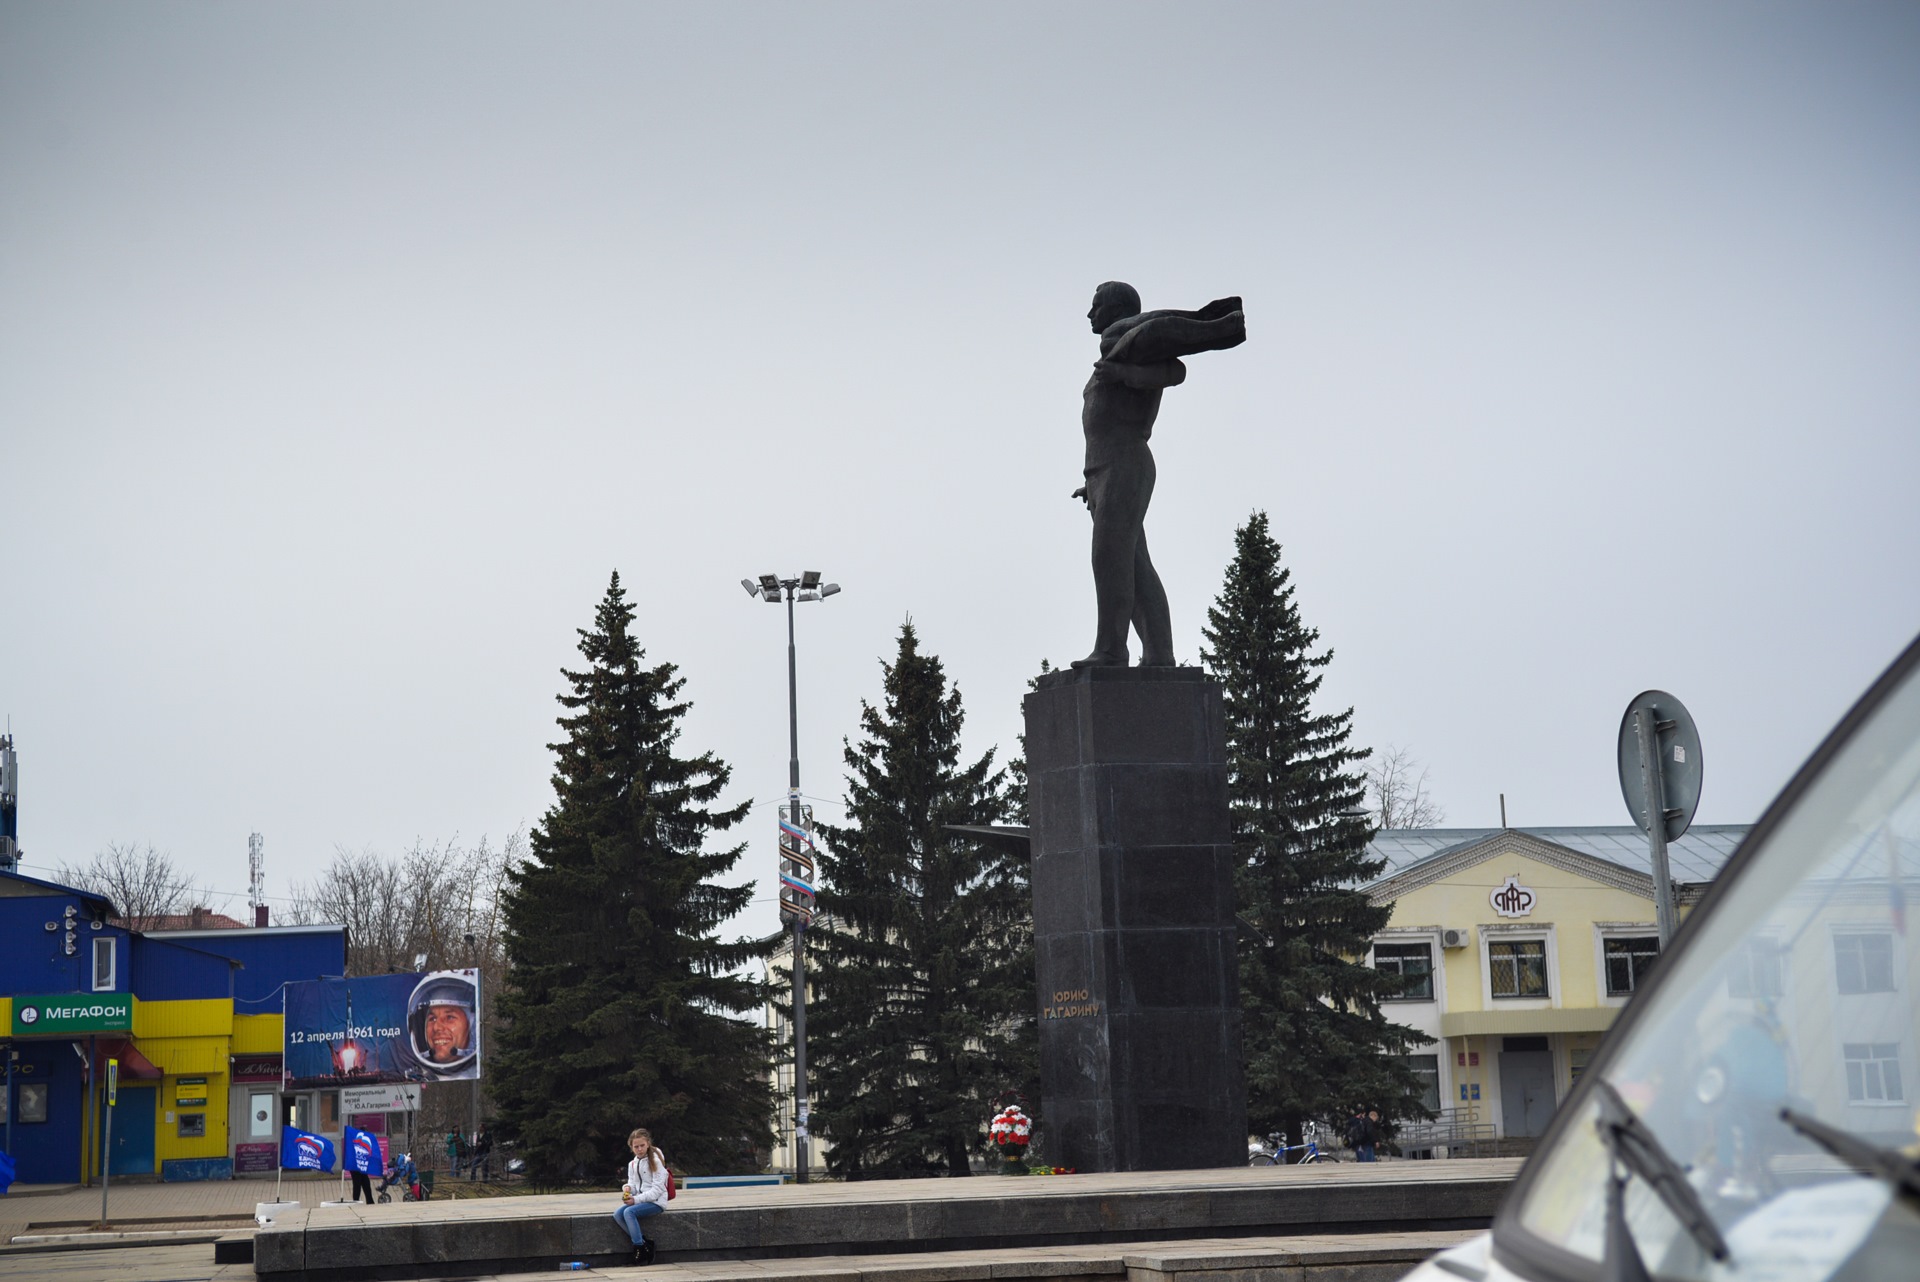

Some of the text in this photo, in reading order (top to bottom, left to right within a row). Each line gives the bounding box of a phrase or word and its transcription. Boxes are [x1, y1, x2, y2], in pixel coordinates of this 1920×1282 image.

[1053, 989, 1089, 1003] ЮРИЮ
[1044, 1004, 1100, 1019] ГАГАРИНУ
[290, 1026, 401, 1044] 12 апреля 1961 года
[344, 1088, 386, 1097] Мемориальный
[354, 1102, 391, 1110] Ю.А.Гагарина
